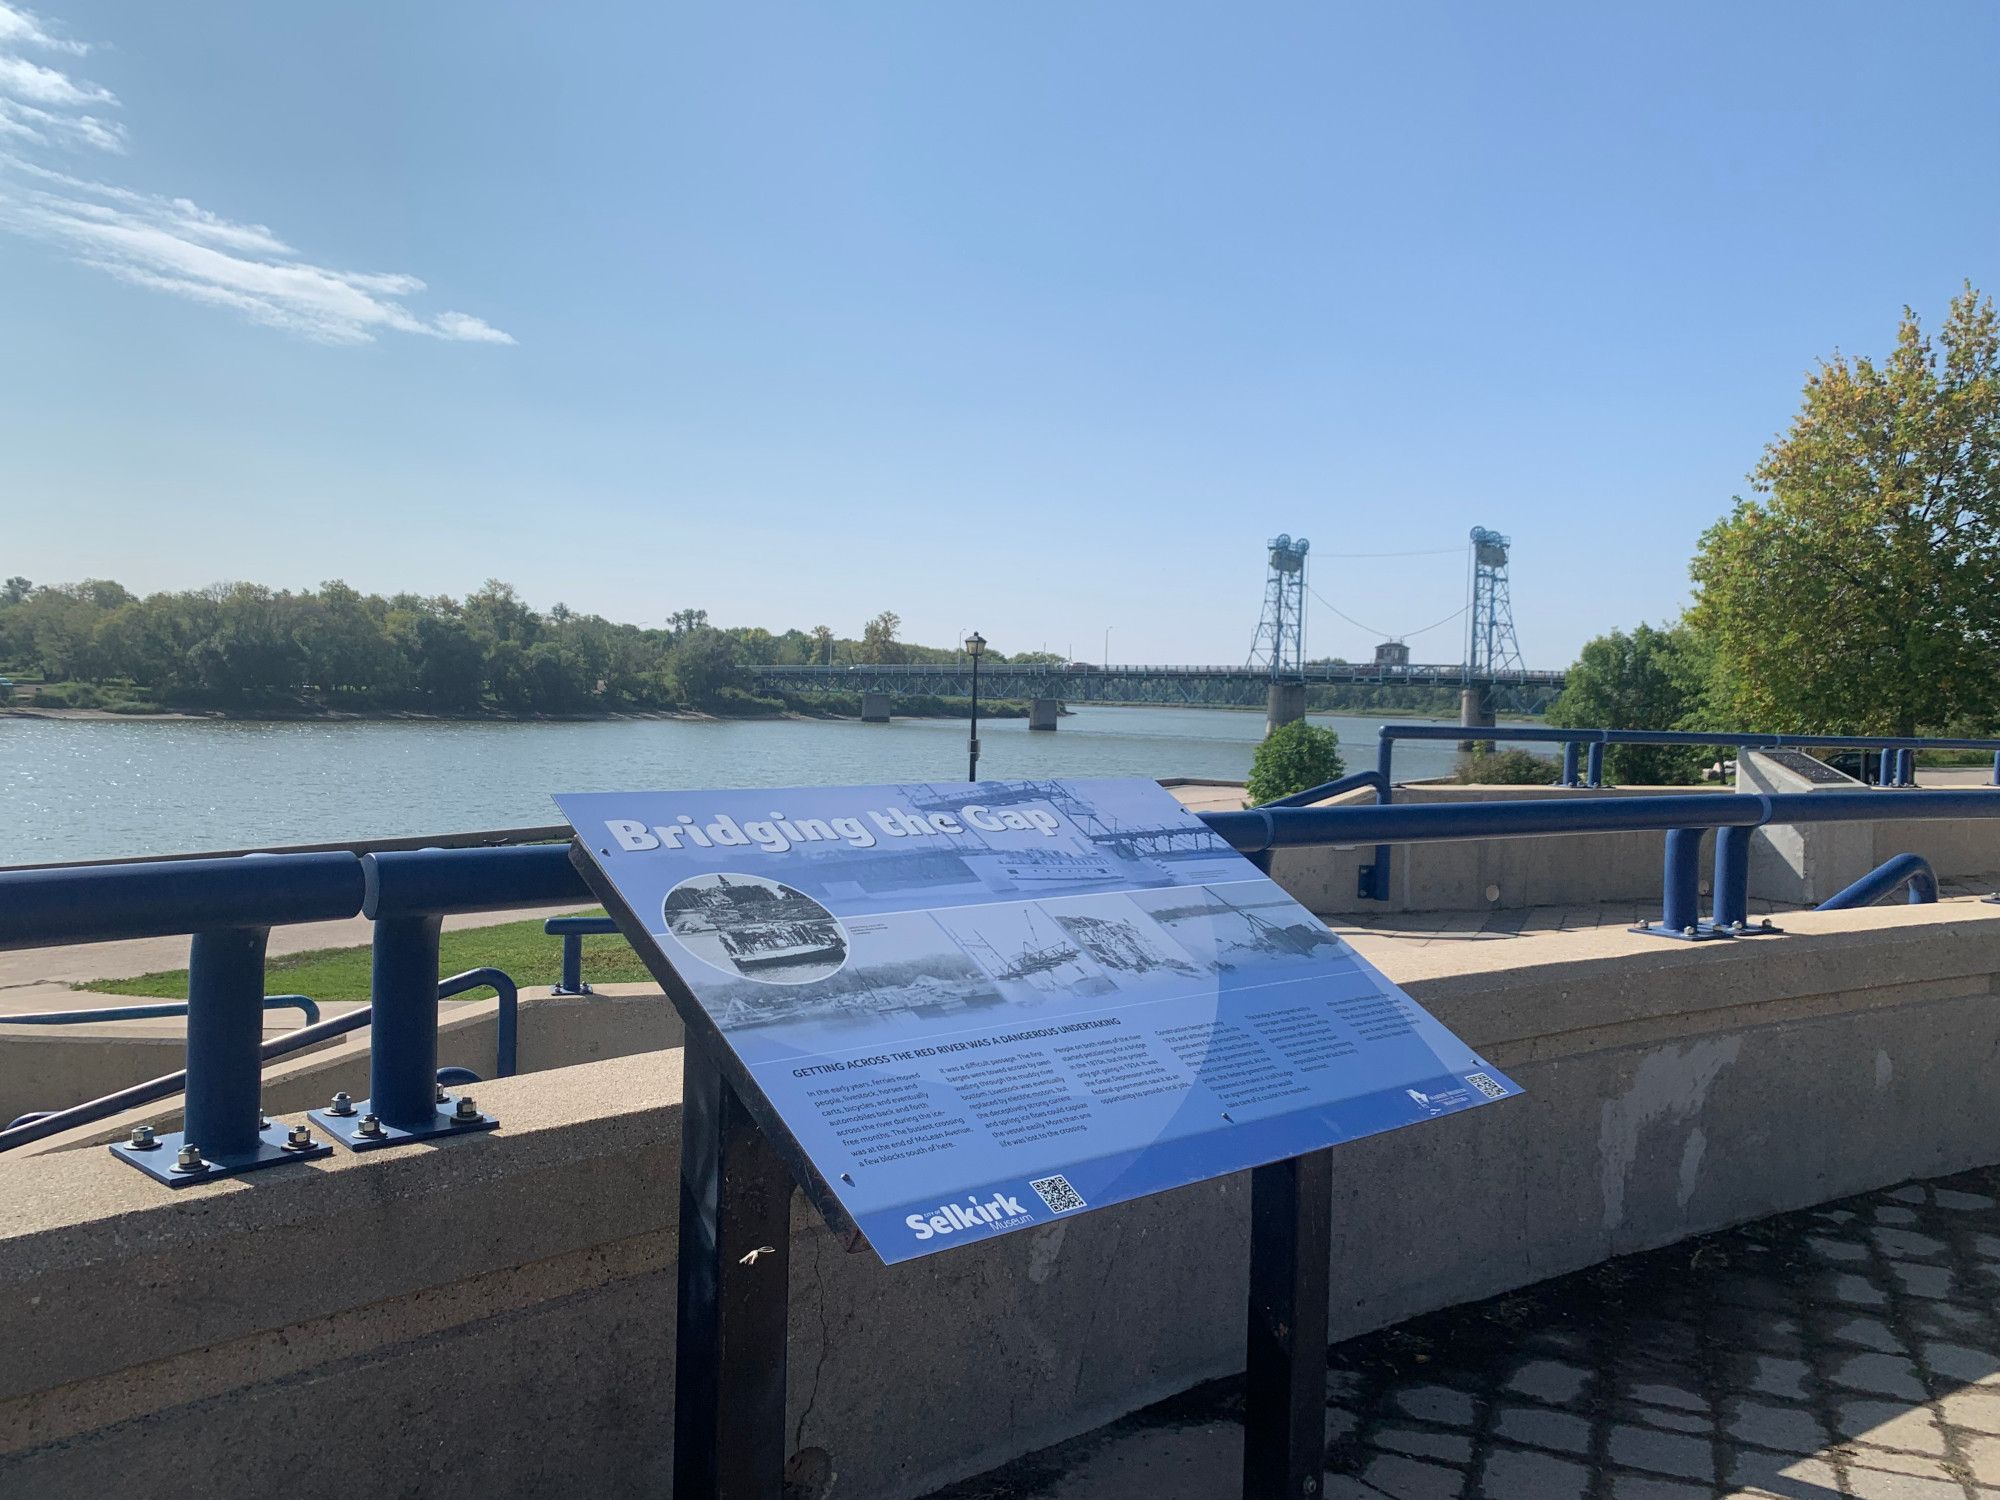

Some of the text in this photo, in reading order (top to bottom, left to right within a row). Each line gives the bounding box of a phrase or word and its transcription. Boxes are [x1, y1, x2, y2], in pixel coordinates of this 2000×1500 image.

[604, 805, 1060, 852] Bridging the Gap
[793, 1063, 845, 1077] GETTING
[847, 1056, 890, 1069] ACROSS
[890, 1052, 914, 1061] THE
[914, 1048, 936, 1058] RED
[936, 1043, 968, 1054] RIVER
[966, 1039, 991, 1048] WAS
[1000, 1028, 1058, 1043] DANGEROUS
[1058, 1018, 1121, 1033] UNDERTAKING
[831, 1085, 850, 1093] early
[896, 1072, 920, 1081] moved
[842, 1090, 879, 1102] livestock,
[878, 1087, 903, 1095] horses
[843, 1103, 876, 1112] bicycles,
[876, 1098, 891, 1106] and
[892, 1092, 928, 1103] eventually
[829, 1114, 876, 1126] automobiles
[876, 1109, 895, 1117] back
[895, 1105, 910, 1113] and
[836, 1128, 861, 1136] across
[894, 1116, 919, 1124] during
[860, 1133, 890, 1143] months.
[906, 1123, 934, 1133] busiest
[935, 1118, 965, 1127] crossing
[891, 1140, 906, 1148] end
[915, 1134, 944, 1143] McLean
[878, 1152, 905, 1162] blocks
[906, 1147, 928, 1157] south
[928, 1144, 936, 1152] of
[906, 1192, 1028, 1240] Selkirk
[988, 1214, 1035, 1232] Museum
